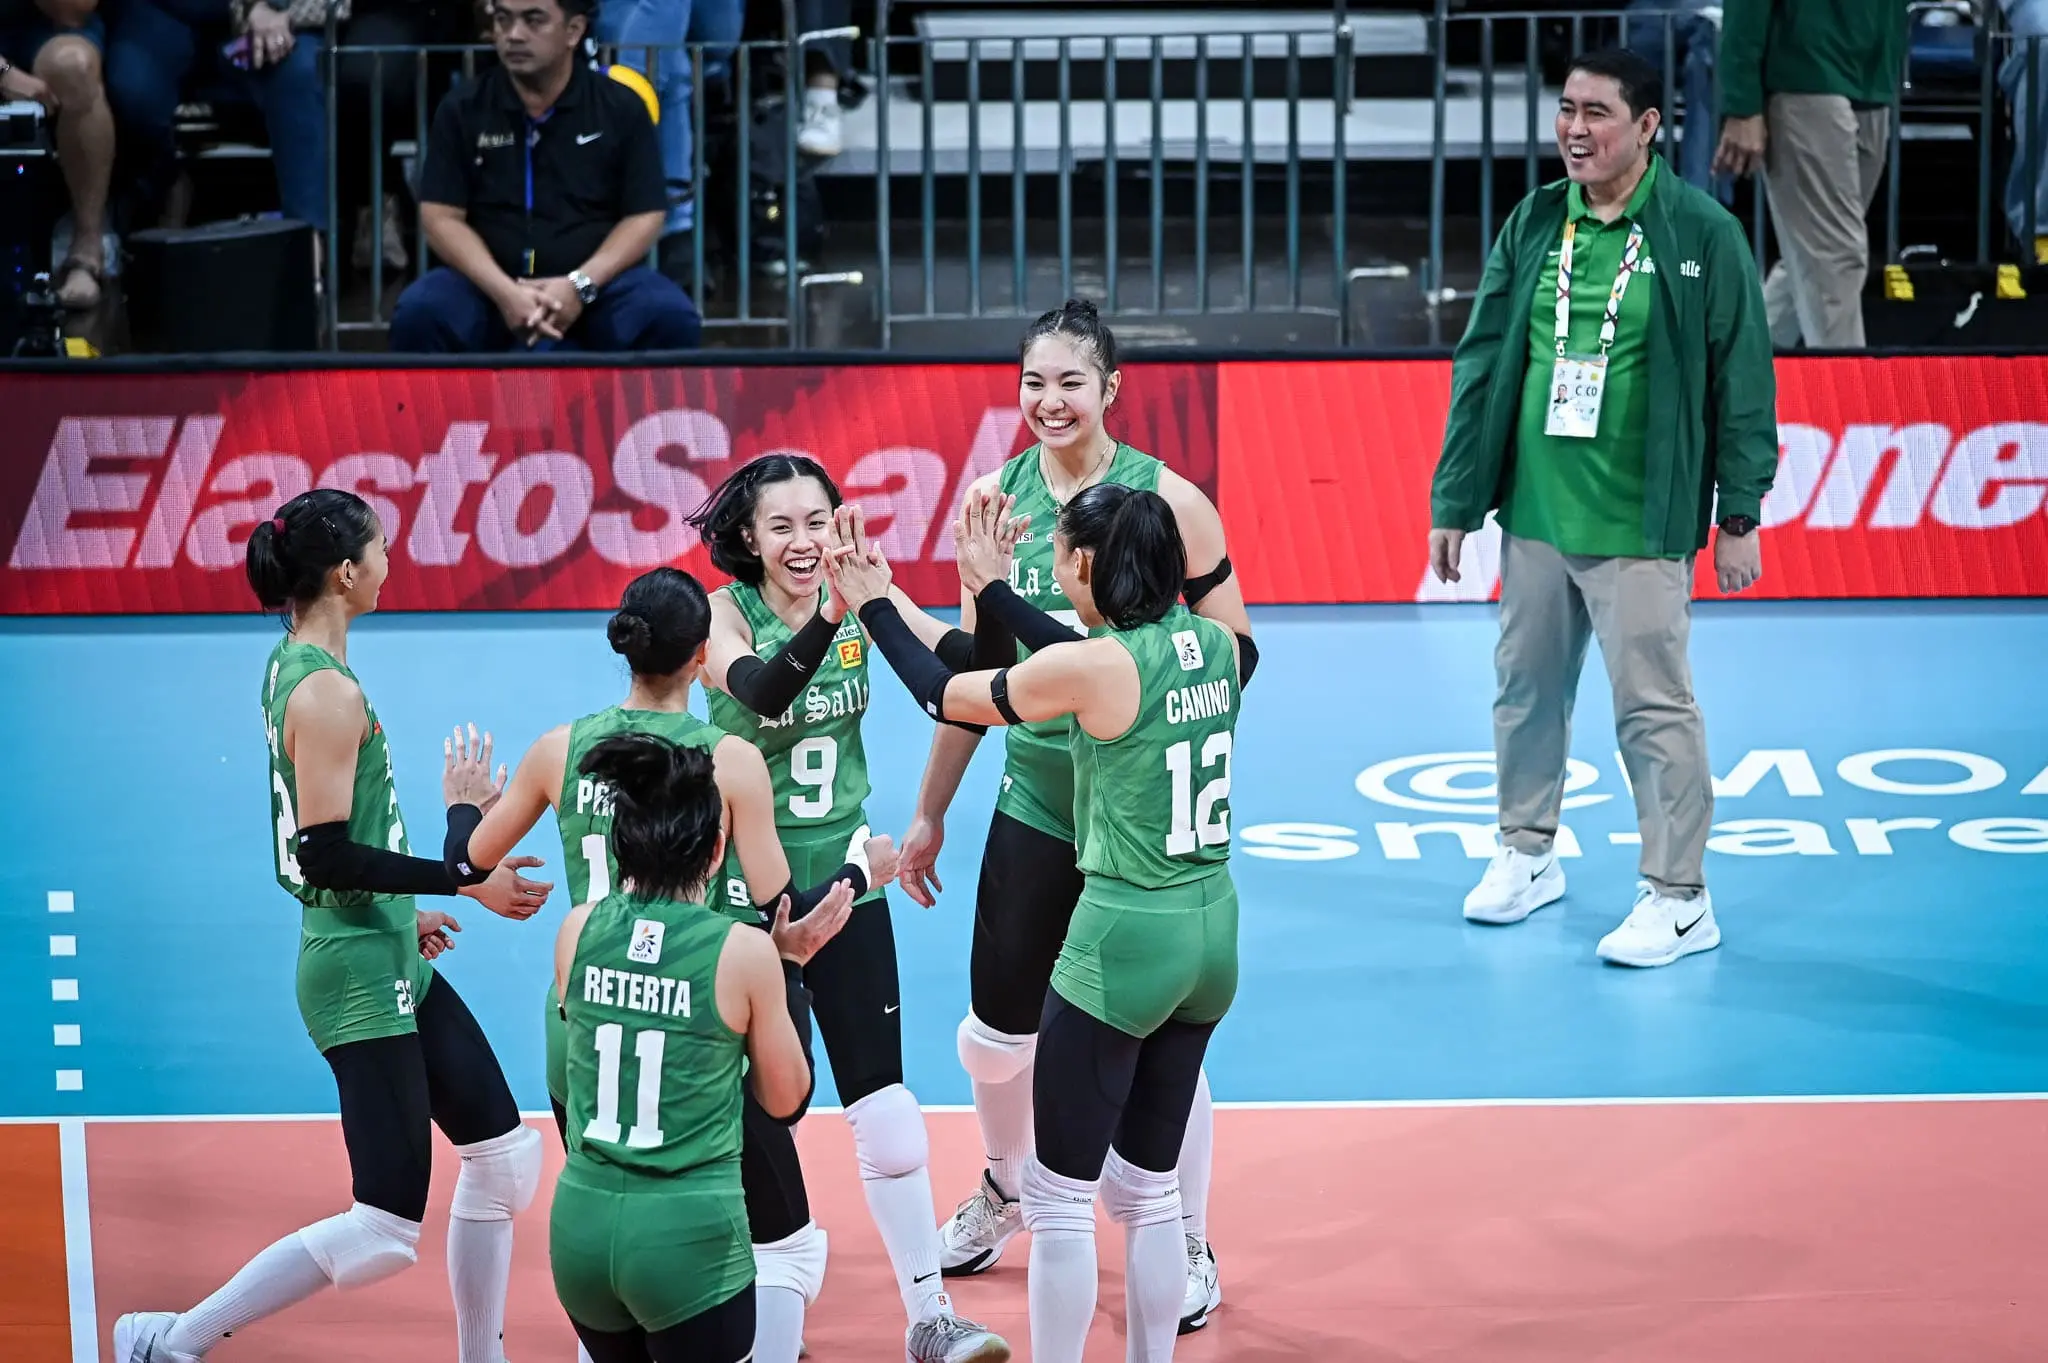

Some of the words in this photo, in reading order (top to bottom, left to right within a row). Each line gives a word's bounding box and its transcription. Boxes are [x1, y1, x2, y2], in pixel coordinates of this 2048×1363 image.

[1680, 259, 1701, 278] alle
[8, 408, 1023, 570] ElastoSal
[1165, 678, 1230, 725] CANINO
[788, 735, 838, 818] 9
[1165, 730, 1233, 857] 12
[1355, 748, 2048, 815] @MO
[581, 833, 611, 904] 1
[727, 878, 750, 907] 9
[583, 965, 691, 1018] RETERTA
[582, 1022, 666, 1149] 11
